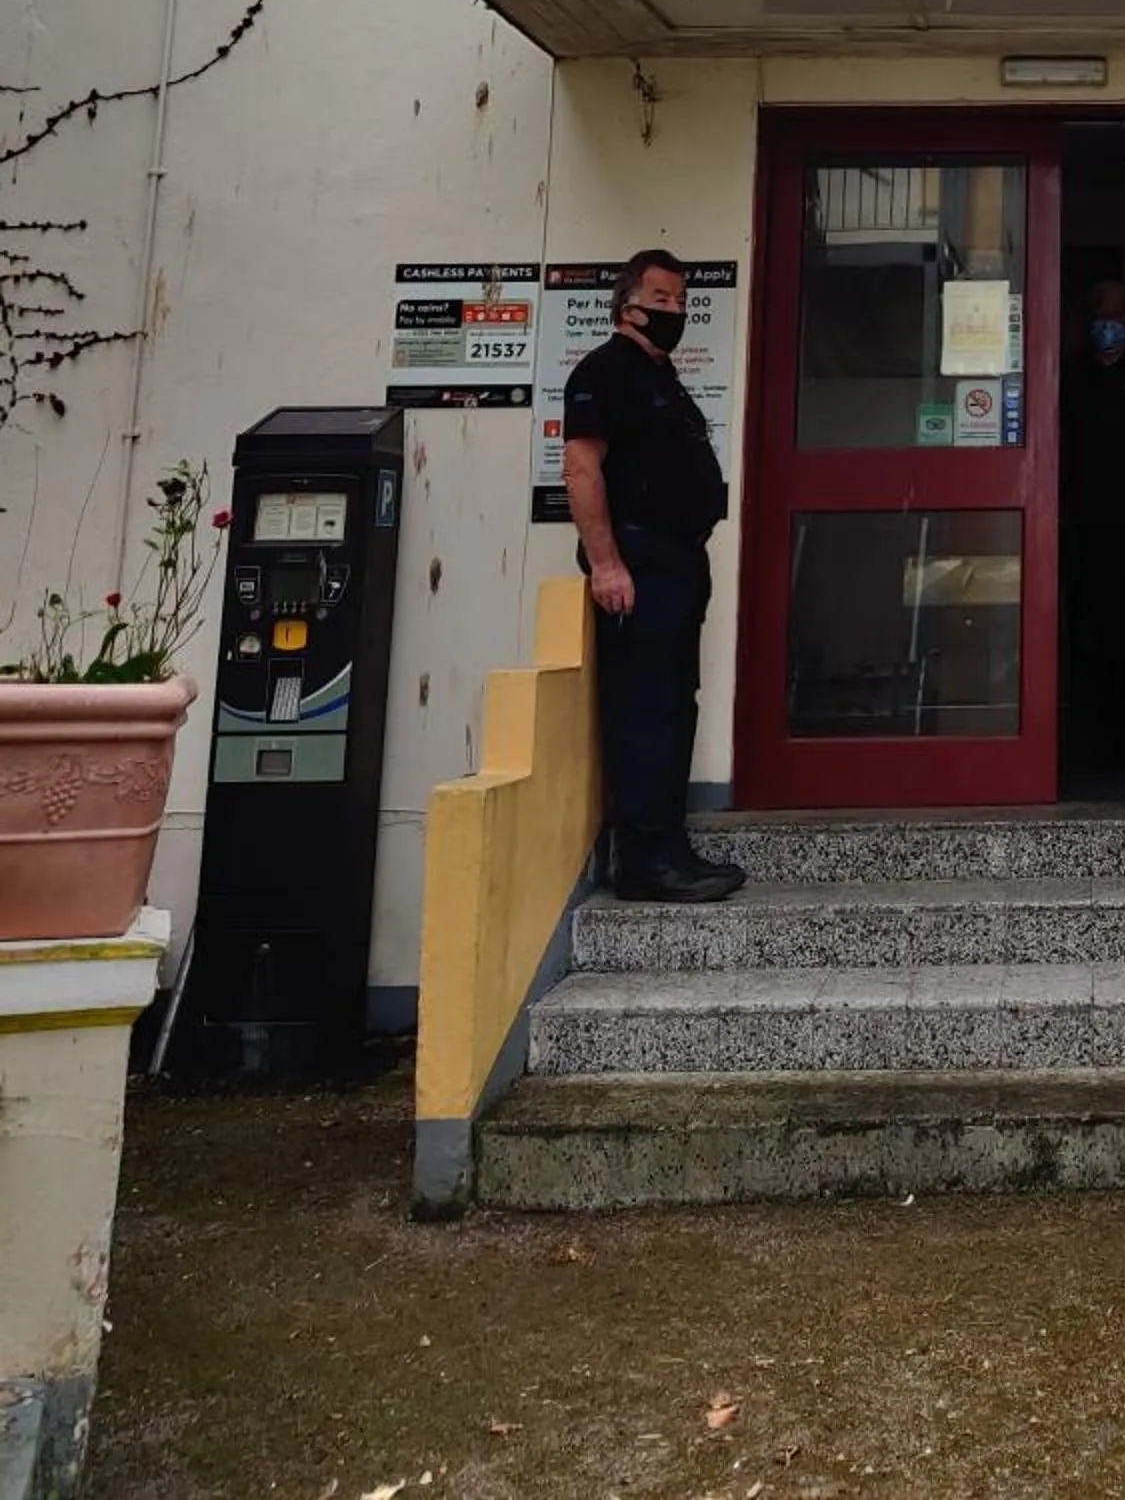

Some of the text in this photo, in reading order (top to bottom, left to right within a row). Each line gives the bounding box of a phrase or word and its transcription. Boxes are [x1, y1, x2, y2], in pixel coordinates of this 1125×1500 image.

[403, 267, 465, 277] CASHLESS
[694, 268, 732, 282] Apply
[399, 303, 415, 313] No
[567, 297, 613, 309] Per ho
[687, 296, 712, 308] .00
[566, 313, 613, 327] Overni
[687, 312, 712, 325] .00
[471, 343, 527, 358] 21537
